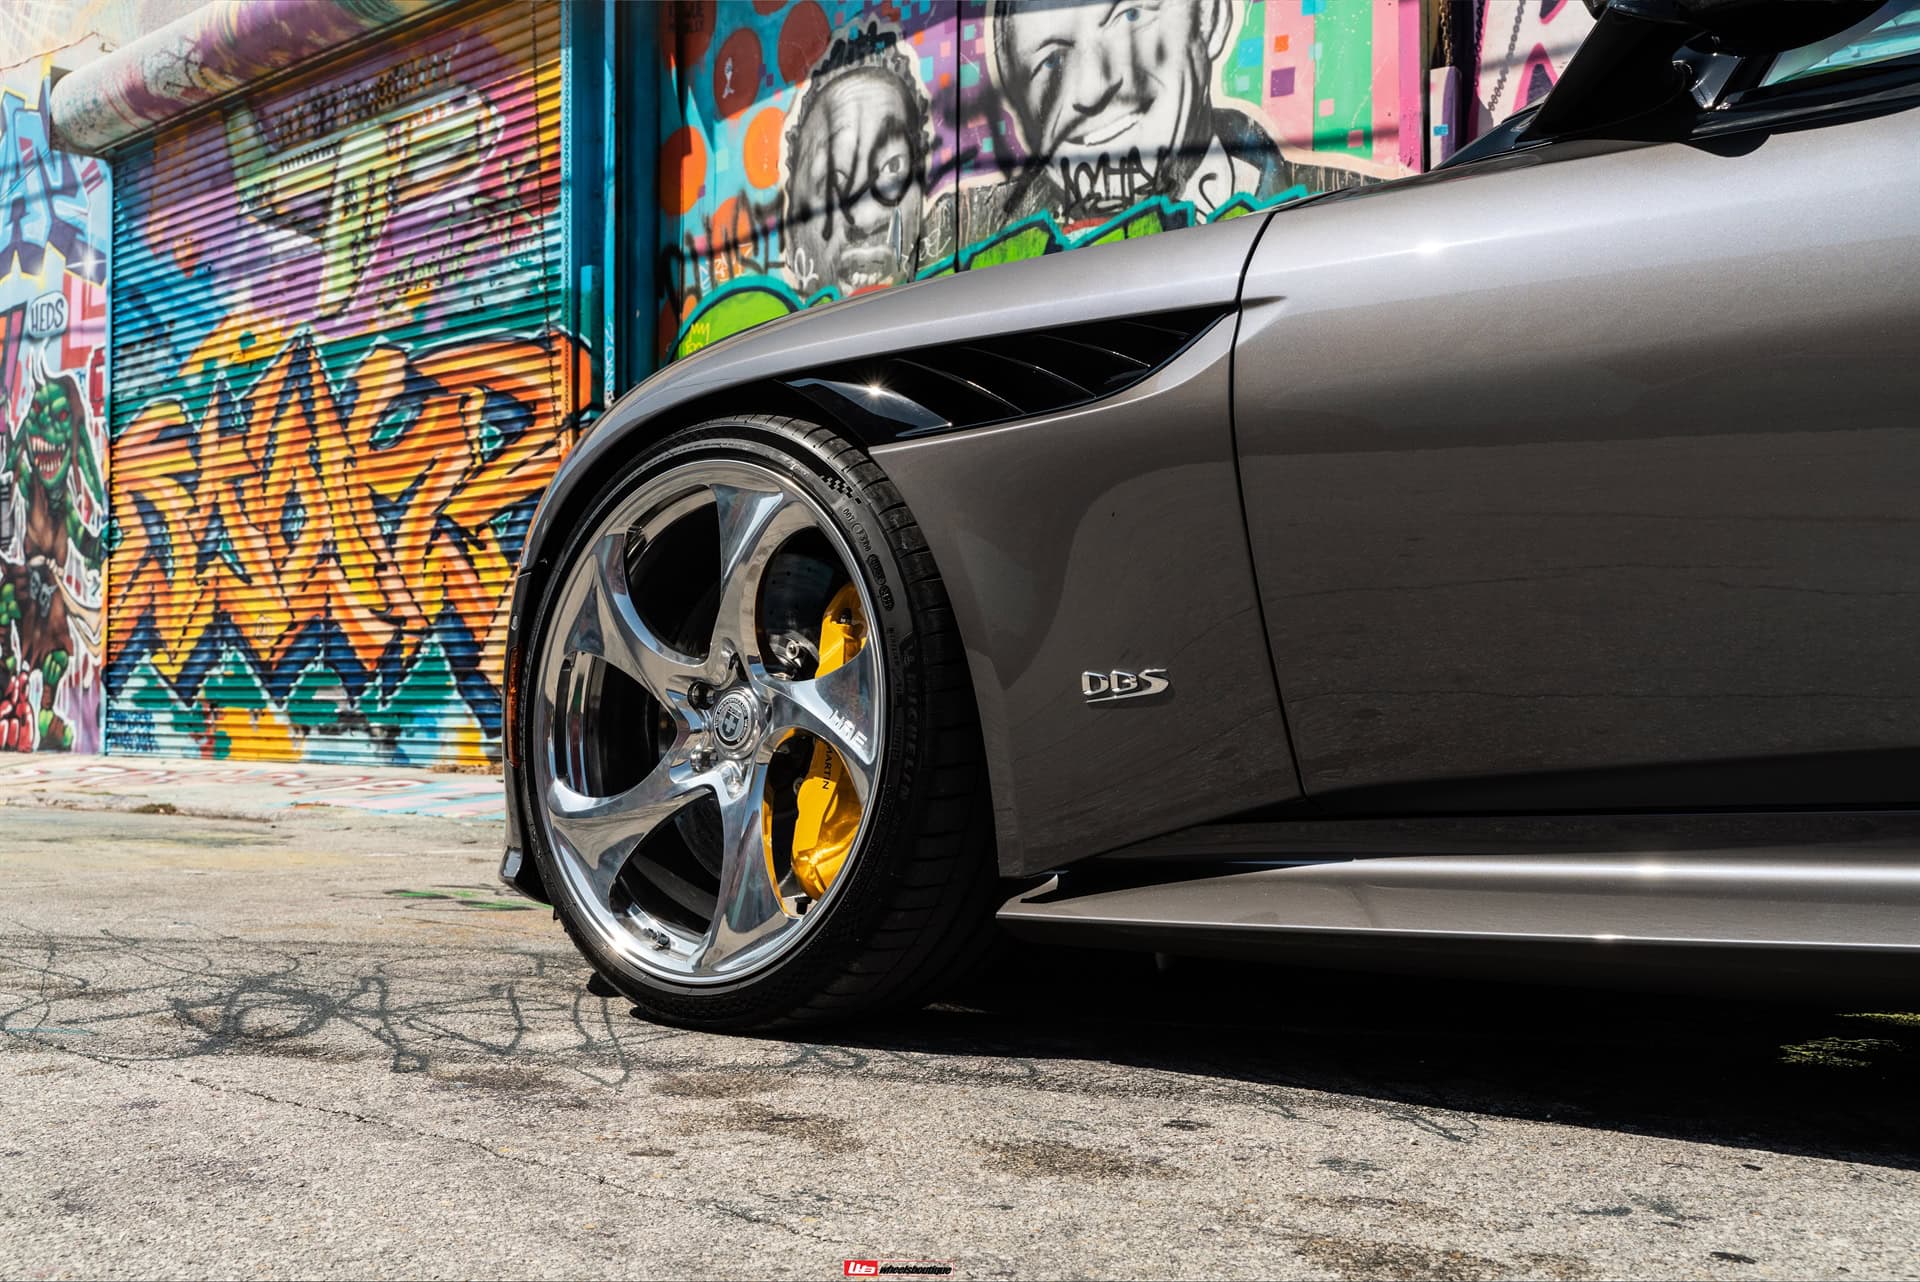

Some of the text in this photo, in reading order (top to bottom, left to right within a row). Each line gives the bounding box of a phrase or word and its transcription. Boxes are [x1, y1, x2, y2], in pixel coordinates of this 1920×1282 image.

[31, 298, 65, 332] HEDS
[1082, 668, 1169, 703] DBS
[829, 710, 868, 748] HRE
